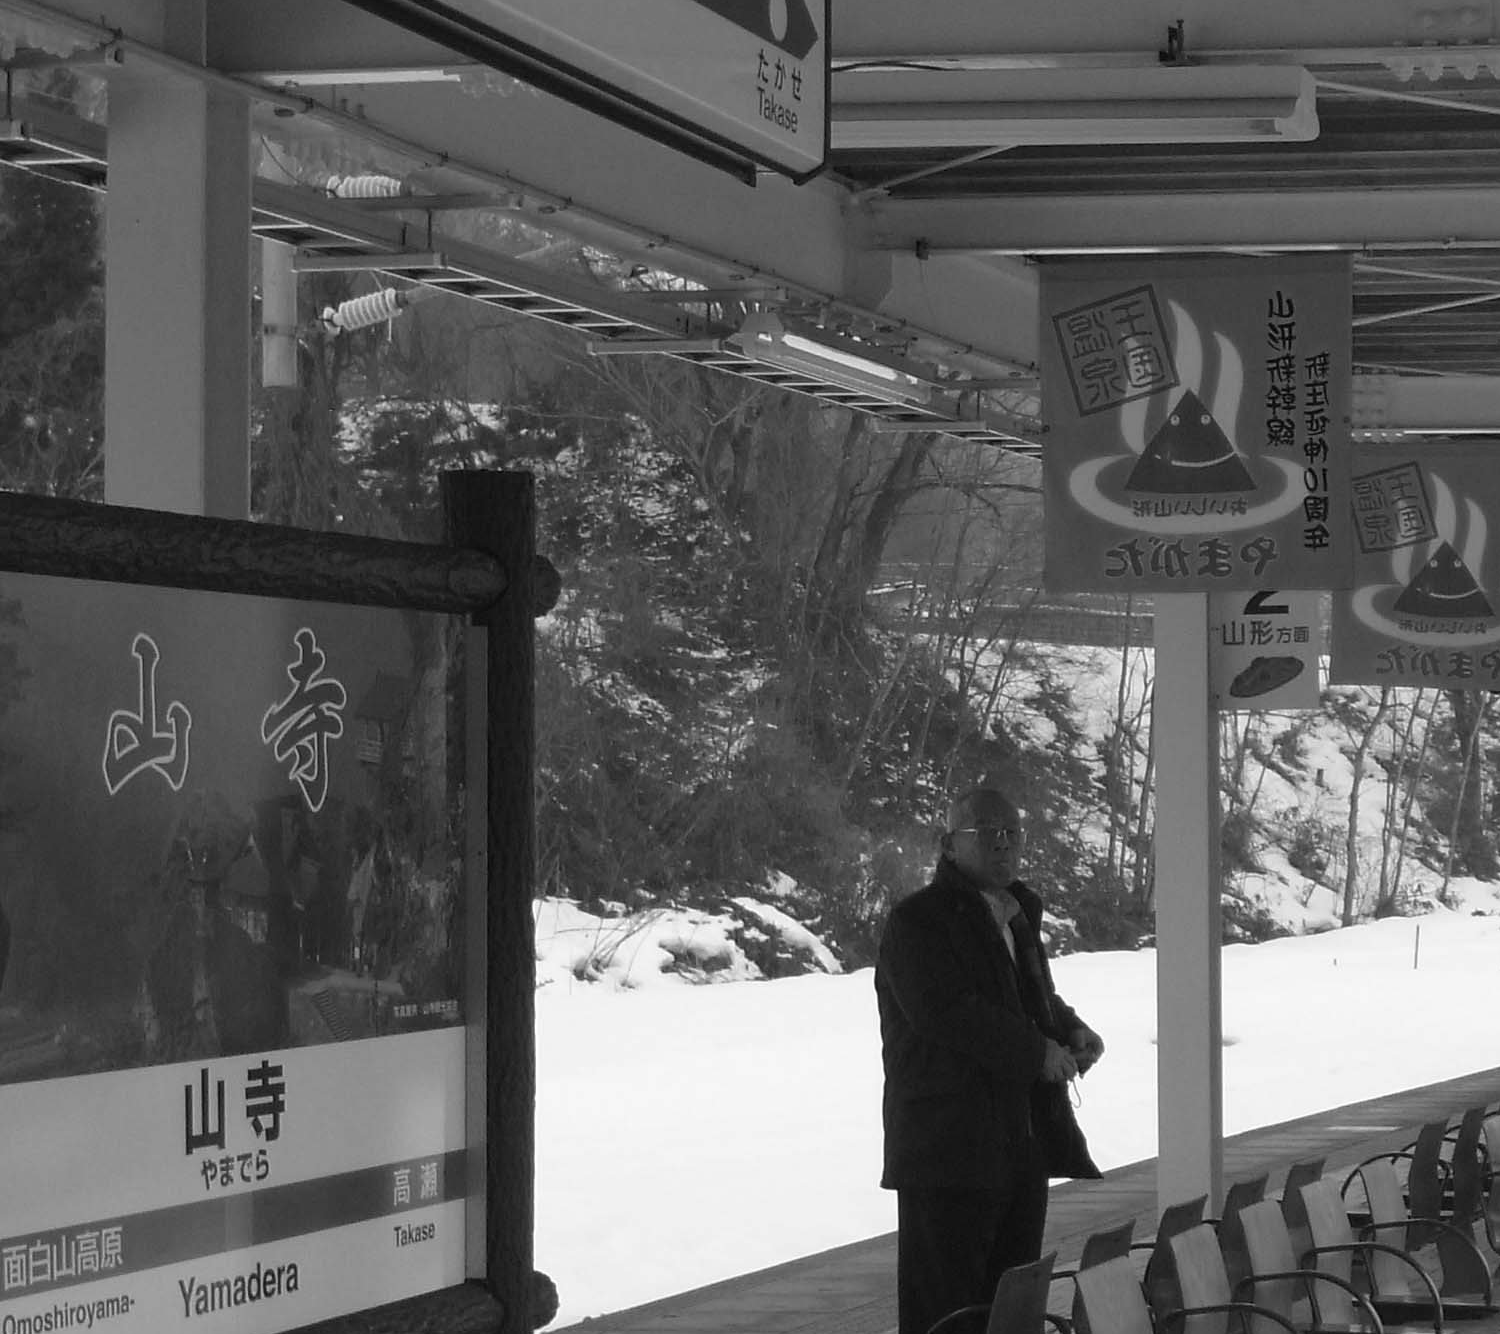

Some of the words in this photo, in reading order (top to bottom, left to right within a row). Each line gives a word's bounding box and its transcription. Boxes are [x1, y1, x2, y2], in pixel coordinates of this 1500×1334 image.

[756, 47, 803, 101] たかせ
[756, 87, 799, 133] Takase
[1222, 619, 1309, 646] 山形方面
[103, 627, 347, 813] 山寺
[185, 1060, 286, 1156] 山寺
[200, 1149, 270, 1192] やまでら
[393, 1161, 440, 1209] 高瀬
[393, 1219, 436, 1247] Takase
[2, 1227, 123, 1294] 面白山高原
[178, 1258, 299, 1319] Yamadera
